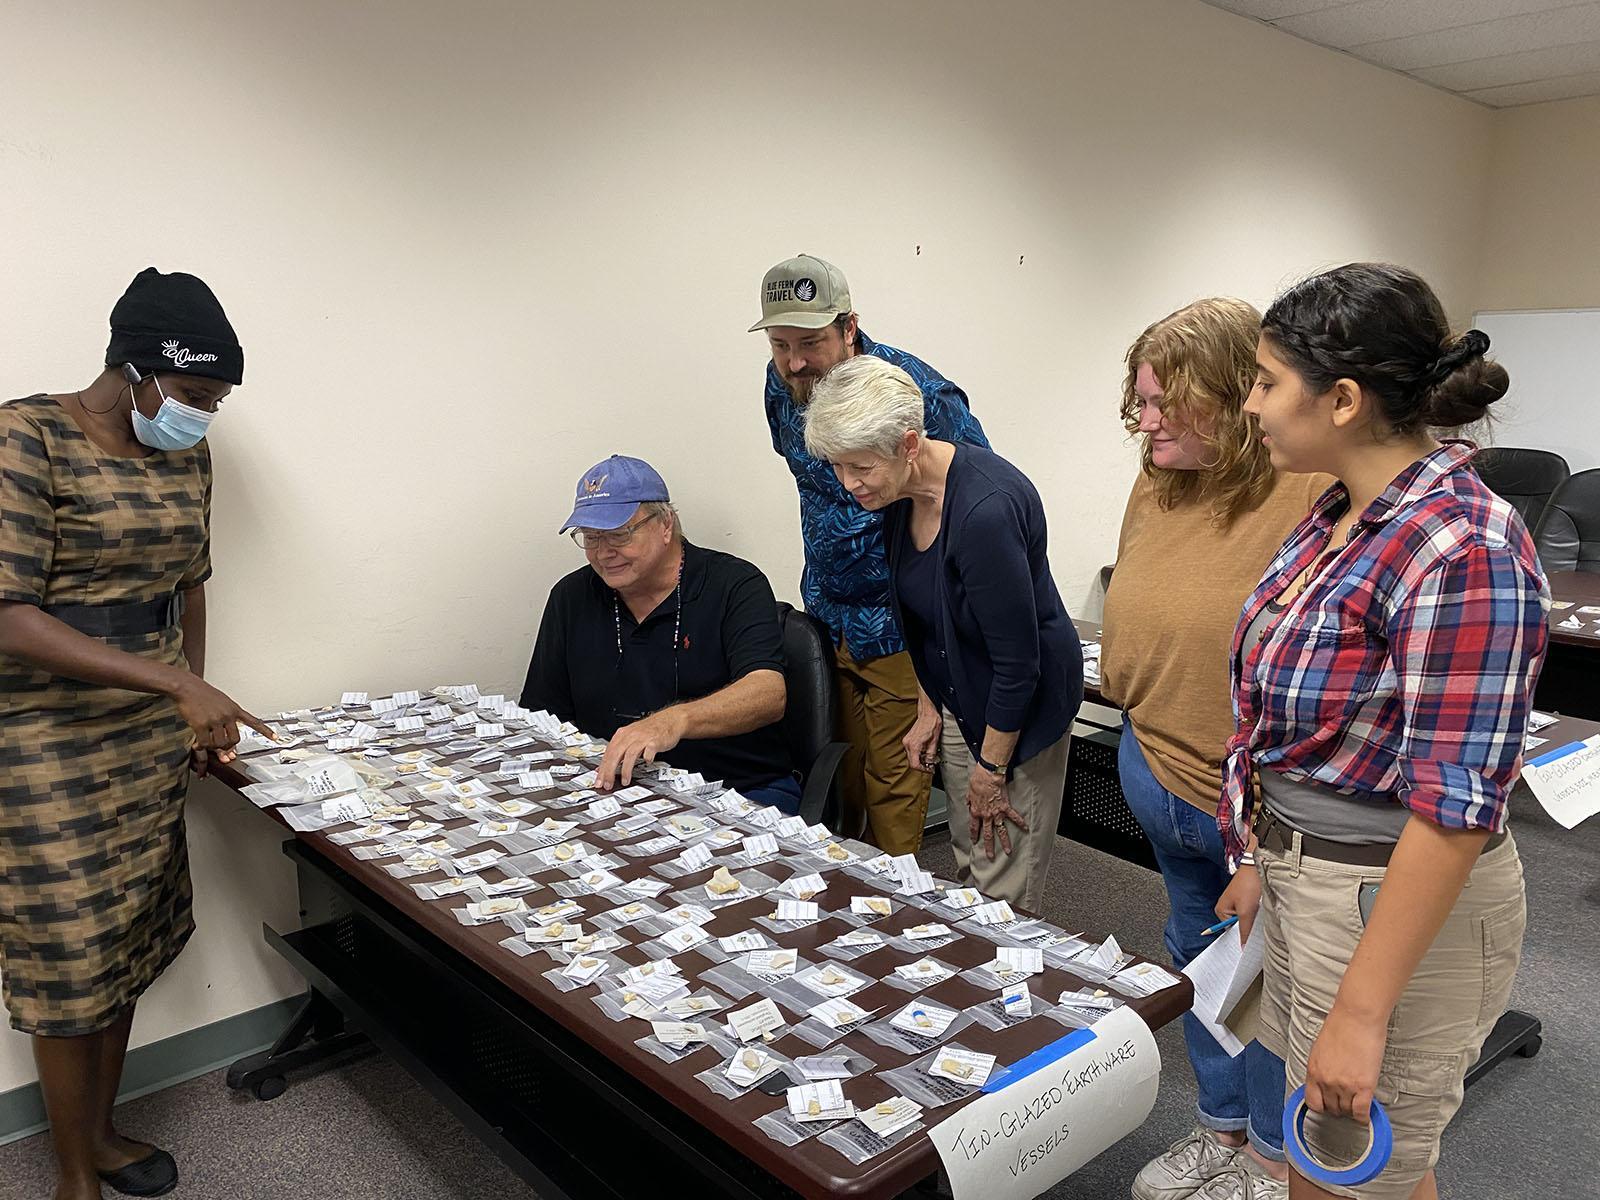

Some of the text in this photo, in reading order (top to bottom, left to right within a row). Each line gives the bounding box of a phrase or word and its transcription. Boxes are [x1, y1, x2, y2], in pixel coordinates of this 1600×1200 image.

[778, 280, 794, 288] FERN
[766, 289, 793, 303] TRAVEL
[161, 347, 218, 368] Queen
[951, 1087, 1063, 1161] TIN-GLAZED
[1008, 1124, 1071, 1177] VESSELS
